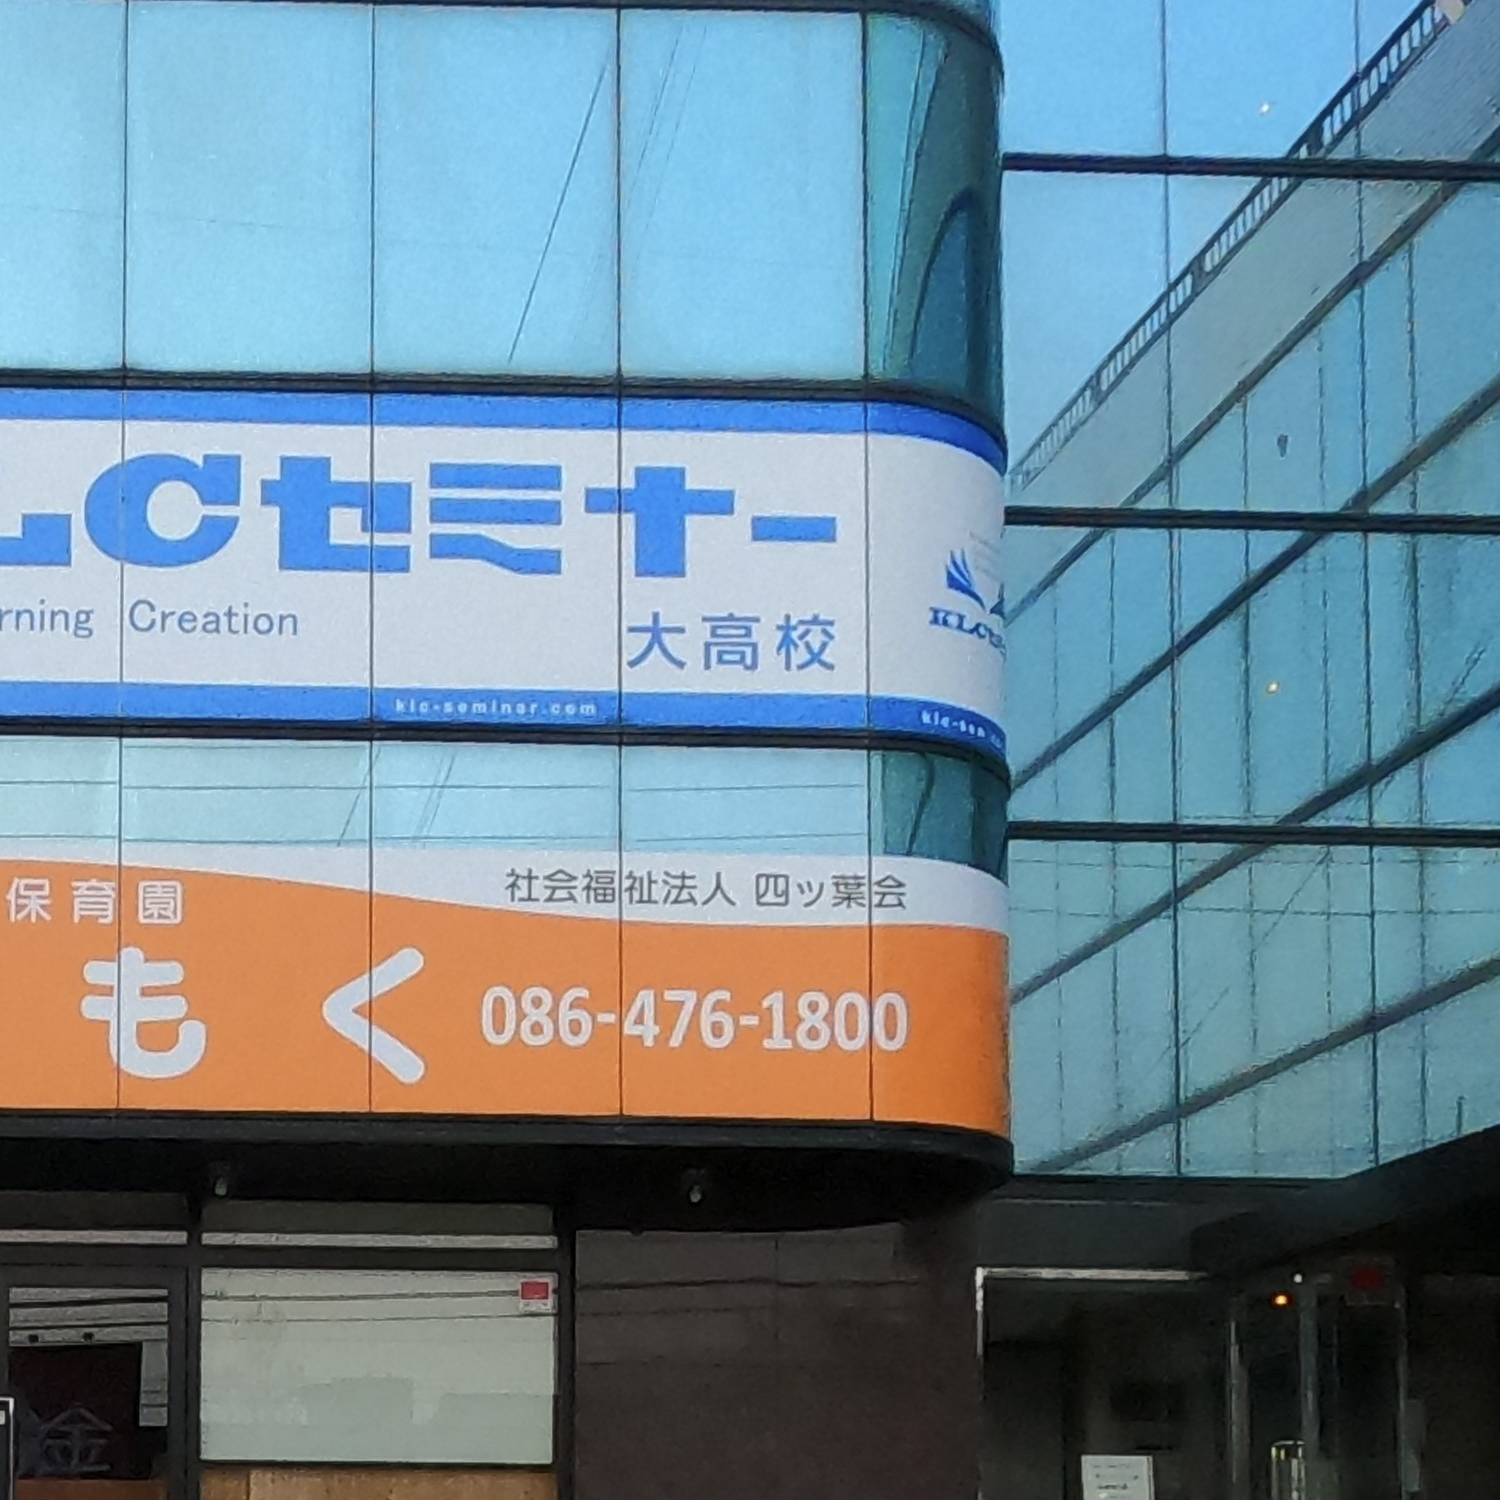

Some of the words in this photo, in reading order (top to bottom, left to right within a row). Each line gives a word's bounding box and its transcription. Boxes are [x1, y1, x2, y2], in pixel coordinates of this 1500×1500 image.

[129, 600, 298, 637] Creation
[626, 611, 837, 673] 大高校
[504, 868, 737, 909] 社会福祉法人
[753, 872, 908, 911] 四ツ葉会
[480, 984, 911, 1052] 086-476-1800
